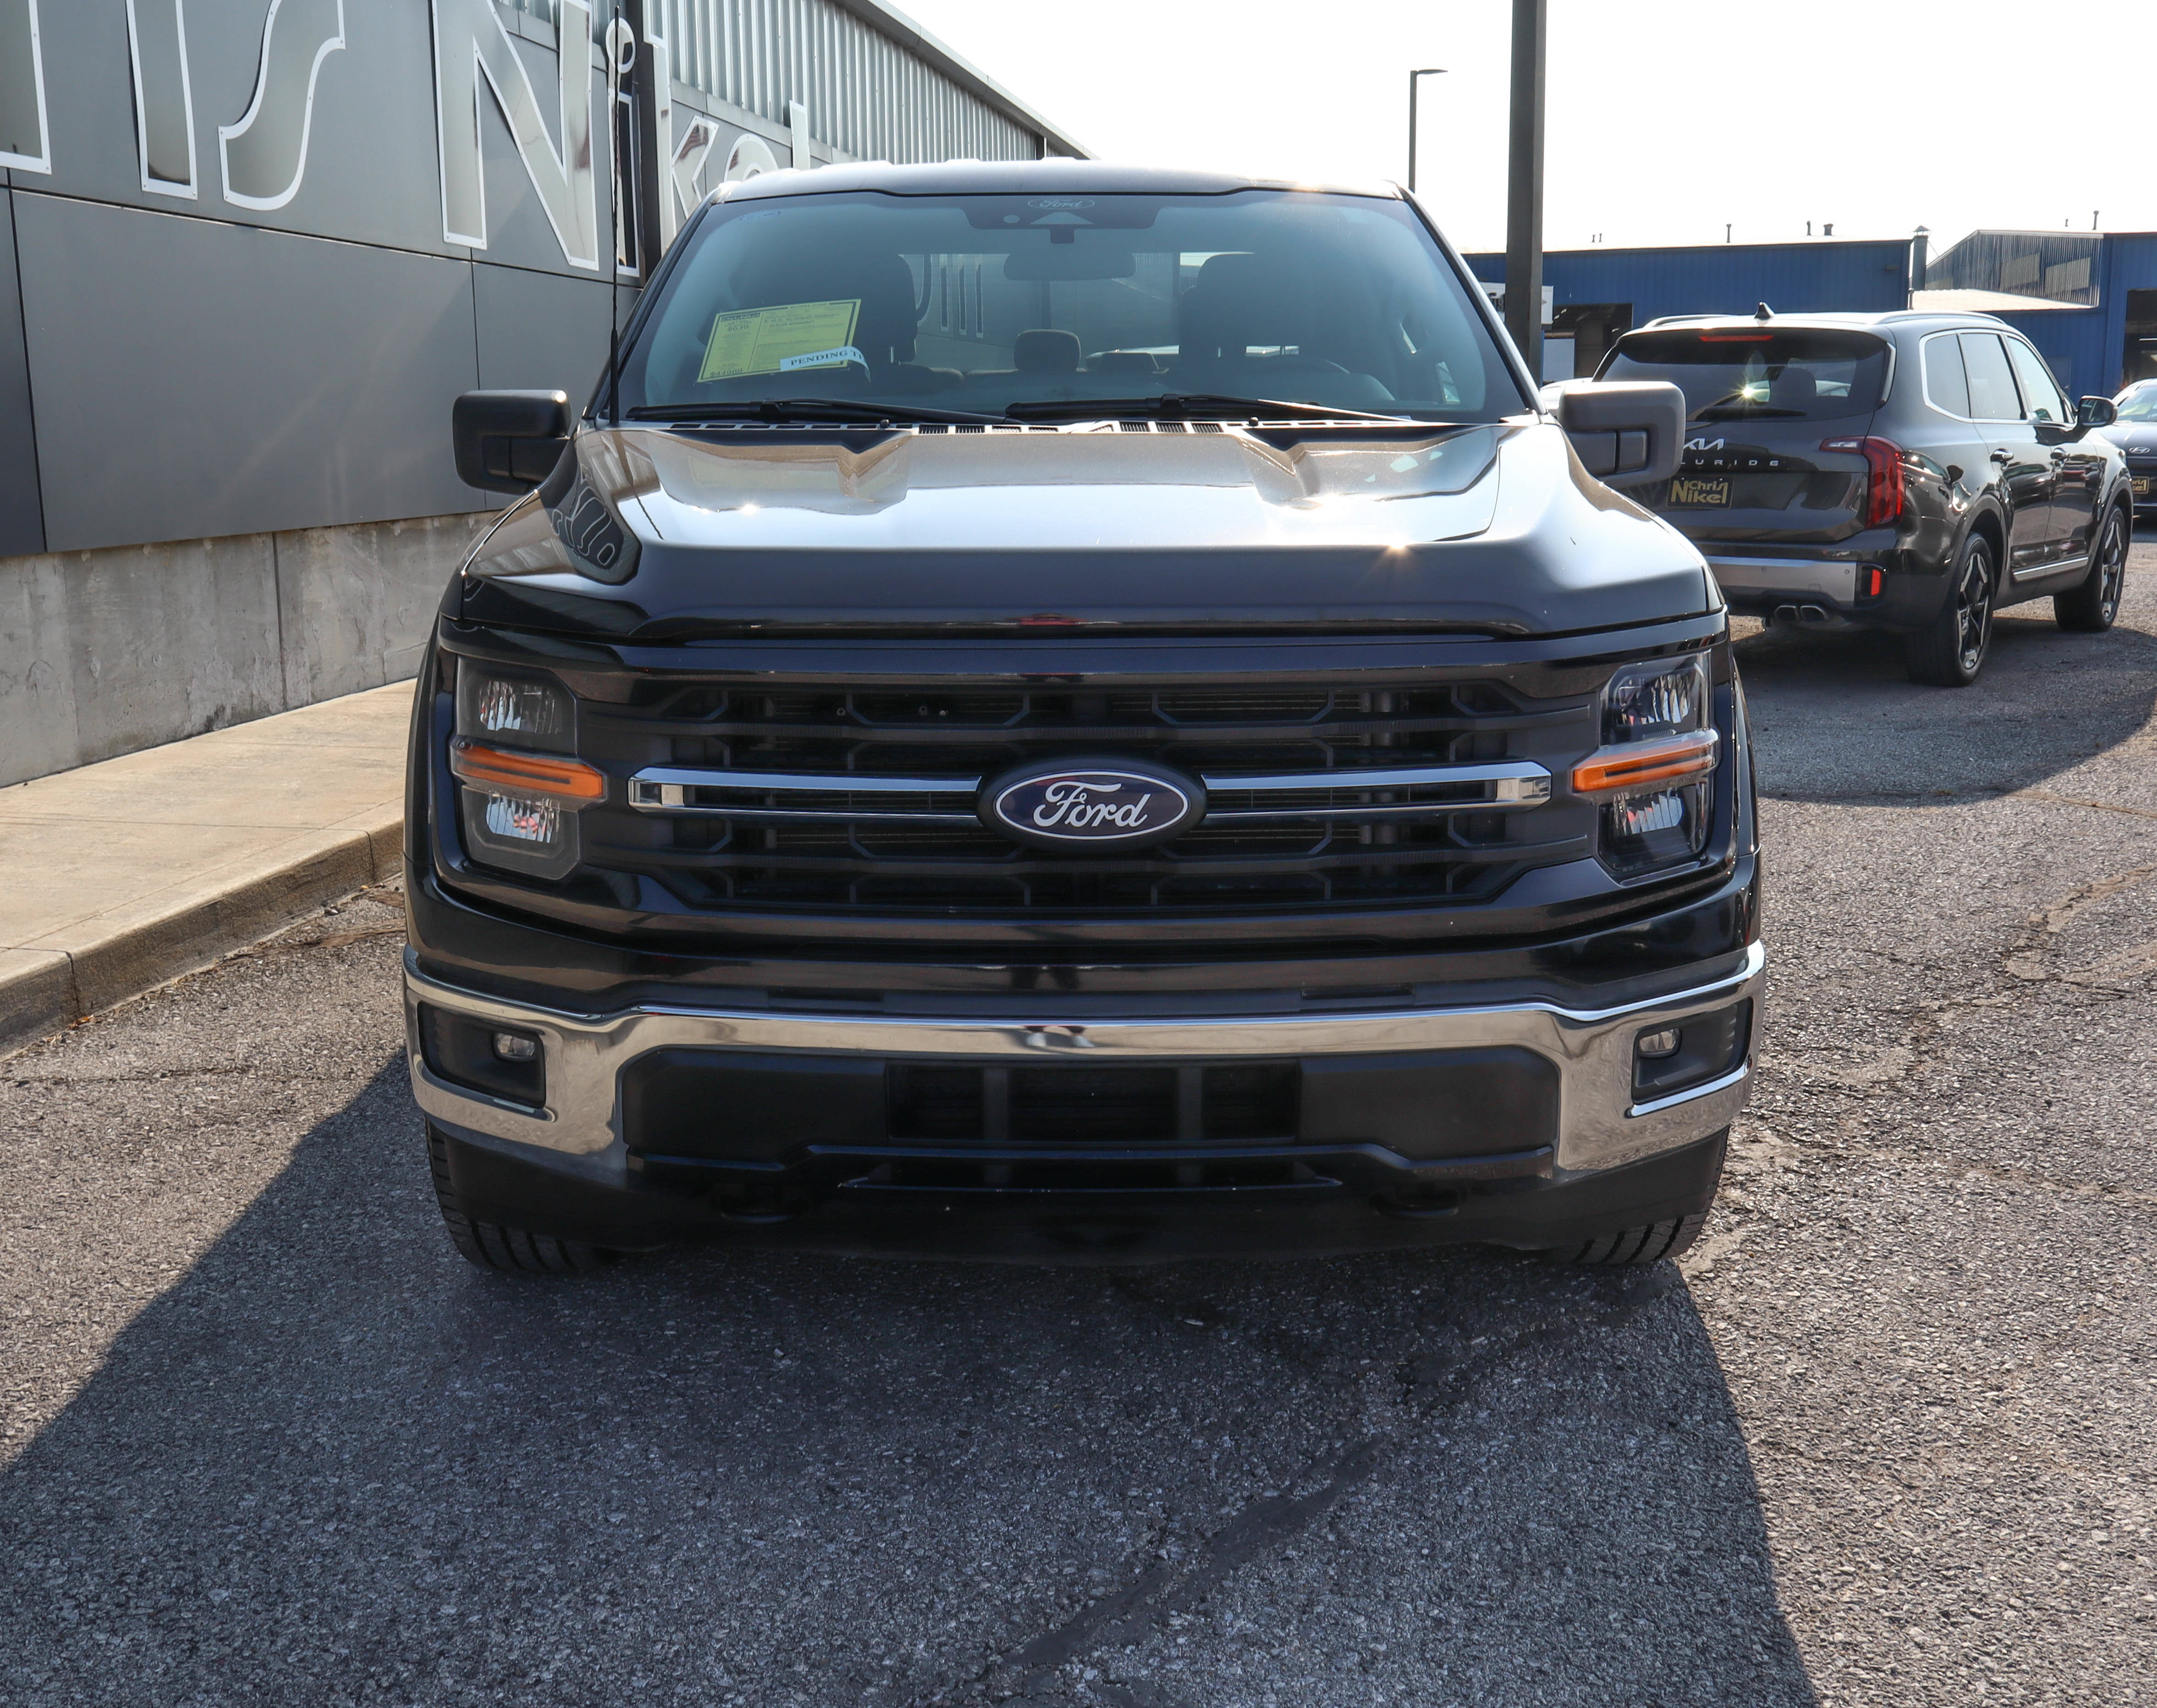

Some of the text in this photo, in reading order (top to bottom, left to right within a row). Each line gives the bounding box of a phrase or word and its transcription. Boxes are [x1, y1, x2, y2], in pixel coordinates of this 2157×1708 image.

[1039, 199, 1083, 208] Ford
[790, 350, 848, 366] PENDING
[1670, 480, 1729, 504] Nikel
[1688, 480, 1728, 491] Chris
[1033, 780, 1151, 828] Ford
